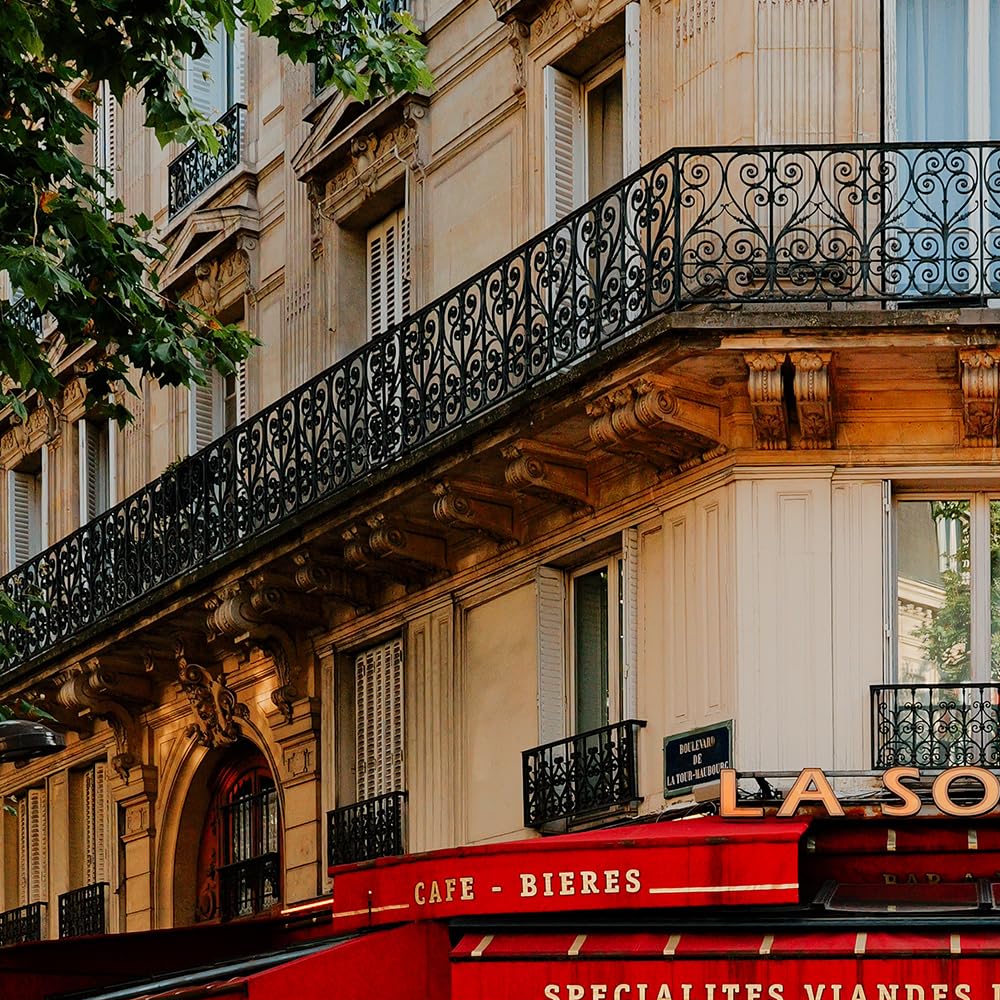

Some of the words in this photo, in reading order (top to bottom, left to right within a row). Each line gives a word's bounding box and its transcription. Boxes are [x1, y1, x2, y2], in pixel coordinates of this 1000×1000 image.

[679, 736, 716, 755] BOULEVARD
[692, 753, 703, 765] DE
[666, 775, 675, 786] LA
[719, 767, 846, 817] LA
[414, 877, 475, 905] CAFE
[519, 869, 641, 897] BIERES
